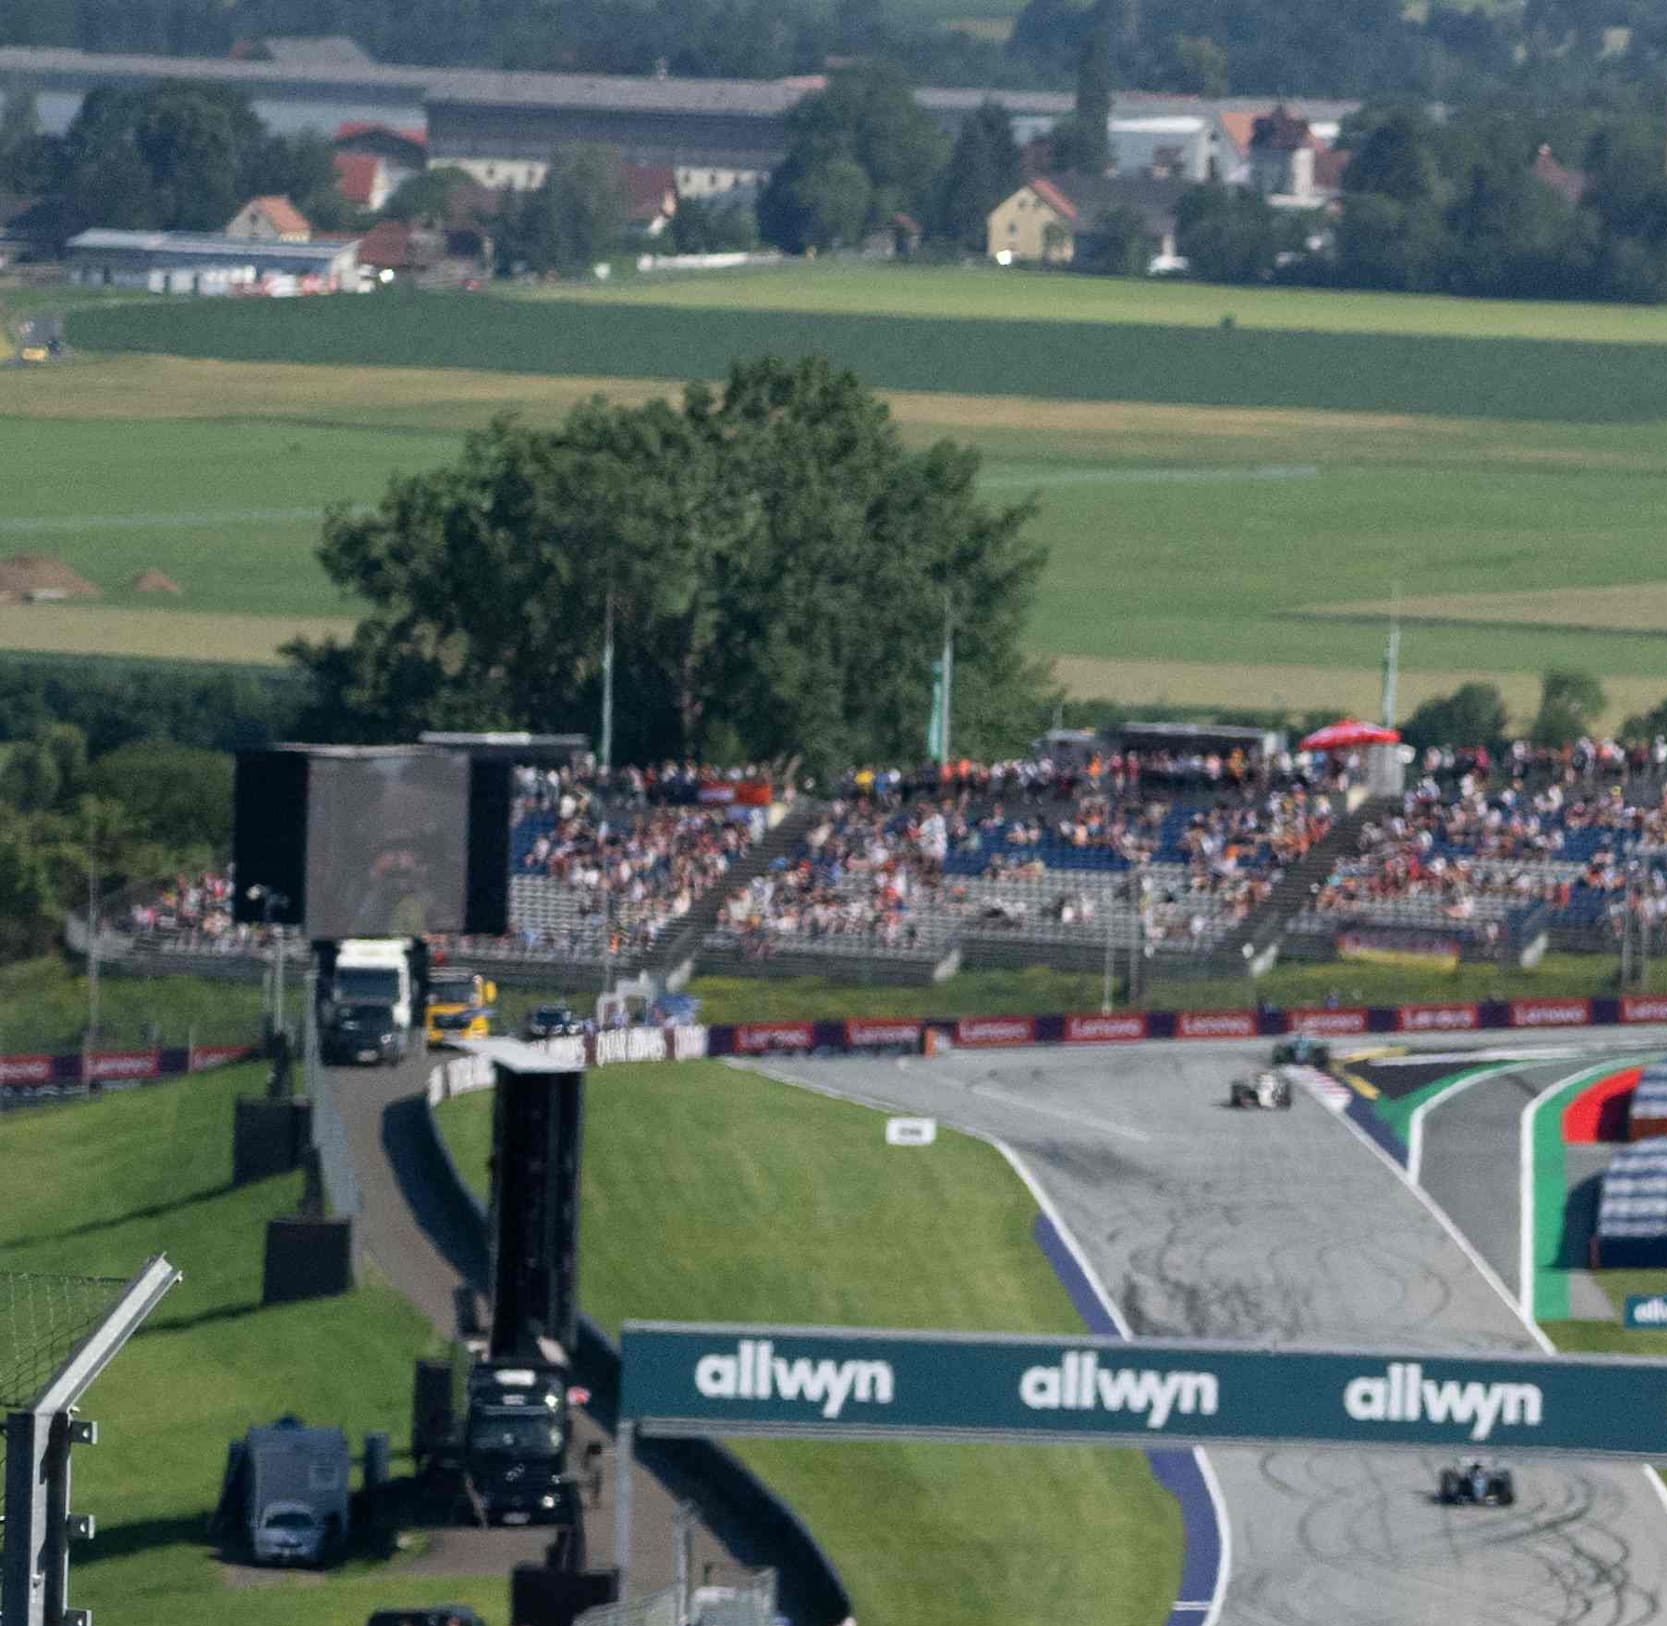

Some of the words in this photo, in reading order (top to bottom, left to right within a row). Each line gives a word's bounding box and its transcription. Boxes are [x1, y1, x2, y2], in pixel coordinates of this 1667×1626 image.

[695, 1340, 894, 1418] allwyn
[1019, 1350, 1219, 1428] allwyn
[1344, 1363, 1543, 1440] allwyn
